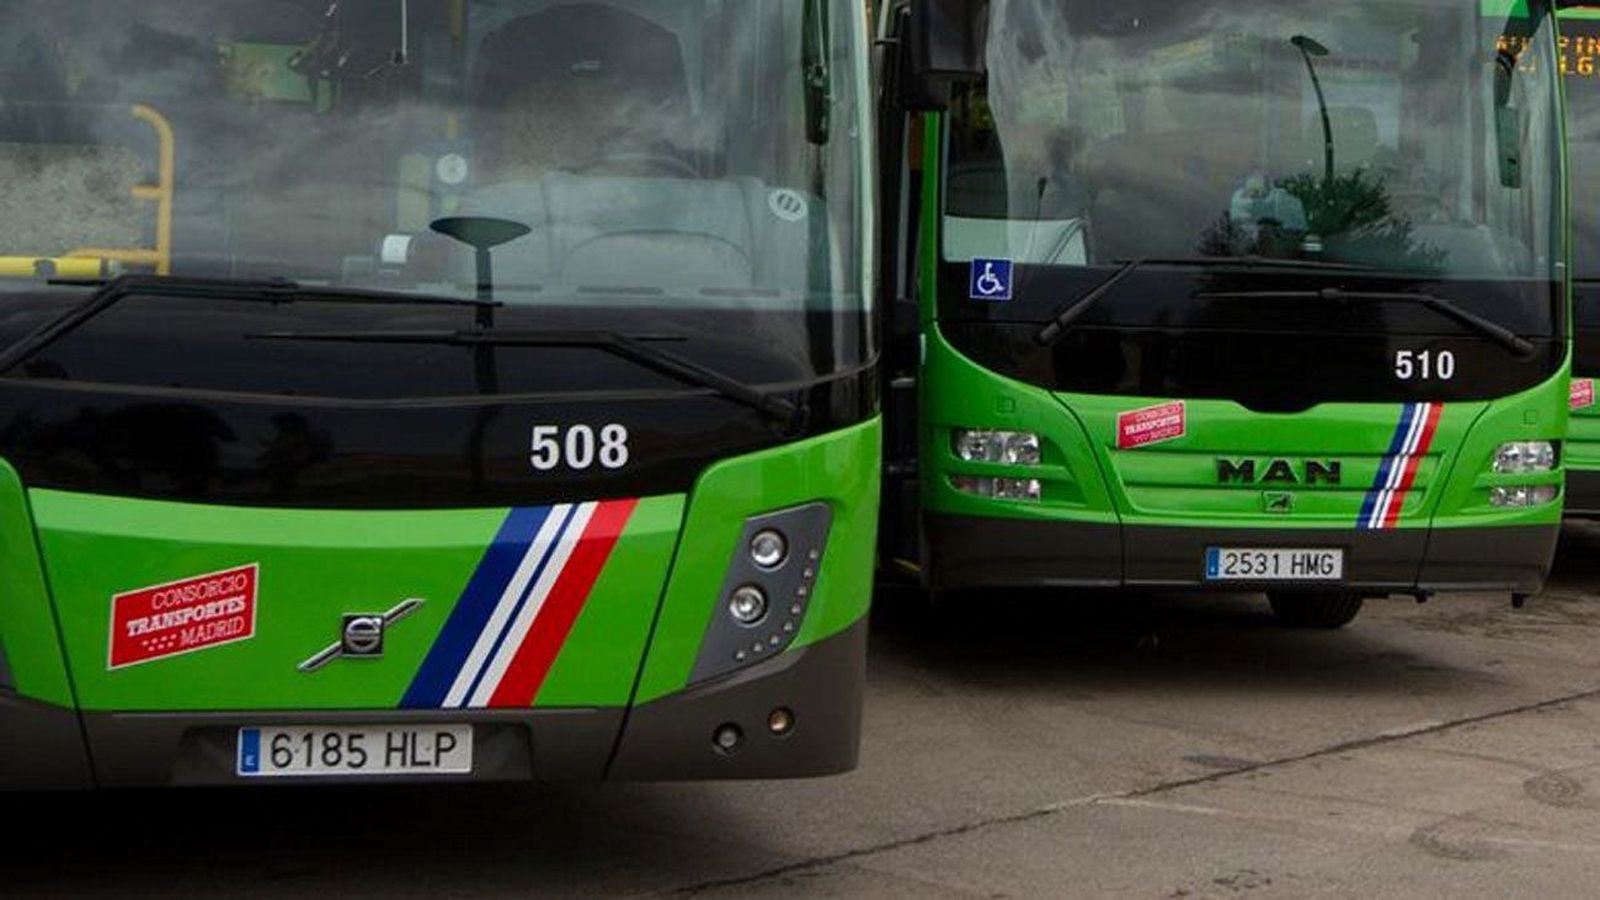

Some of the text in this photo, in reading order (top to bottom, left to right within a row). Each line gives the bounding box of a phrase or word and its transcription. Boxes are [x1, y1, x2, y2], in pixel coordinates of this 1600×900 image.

[1395, 350, 1455, 379] 510
[531, 424, 629, 470] 508
[1217, 459, 1341, 484] MAN
[1224, 553, 1334, 575] 2531 HMG
[152, 573, 248, 610] CONSORCIO
[126, 595, 247, 637] TRANSPORTES
[179, 616, 246, 647] MADRID
[270, 732, 457, 769] 6185 HLP
